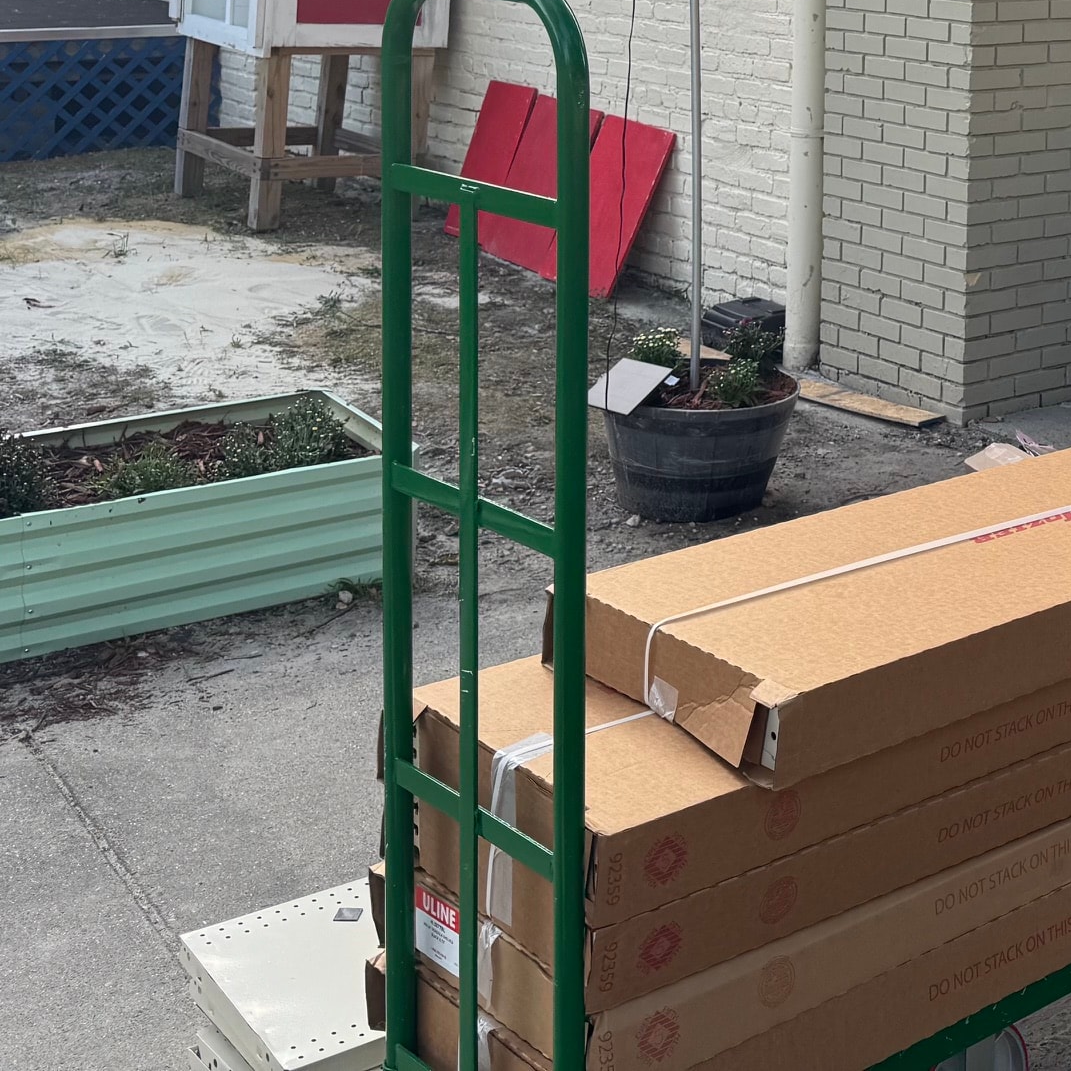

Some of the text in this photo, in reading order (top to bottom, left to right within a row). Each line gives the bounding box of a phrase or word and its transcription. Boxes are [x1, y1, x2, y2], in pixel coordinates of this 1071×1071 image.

[940, 741, 961, 763] DO
[965, 729, 994, 753] NOT
[995, 713, 1034, 742] STACK
[1036, 705, 1055, 725] ON
[937, 822, 959, 843] DO
[962, 809, 992, 834] NOT
[993, 793, 1033, 821] STACK
[1034, 785, 1055, 804] ON
[605, 852, 624, 907] 92359
[934, 893, 955, 916] DO
[958, 878, 986, 905] NOT
[989, 859, 1028, 890] STACK
[1029, 848, 1048, 870] ON
[422, 890, 457, 929] ULINE
[600, 941, 619, 993] 92359
[928, 979, 950, 1003] DO
[952, 961, 982, 990] NOT
[984, 941, 1024, 974] STACK
[1025, 930, 1046, 953] ON
